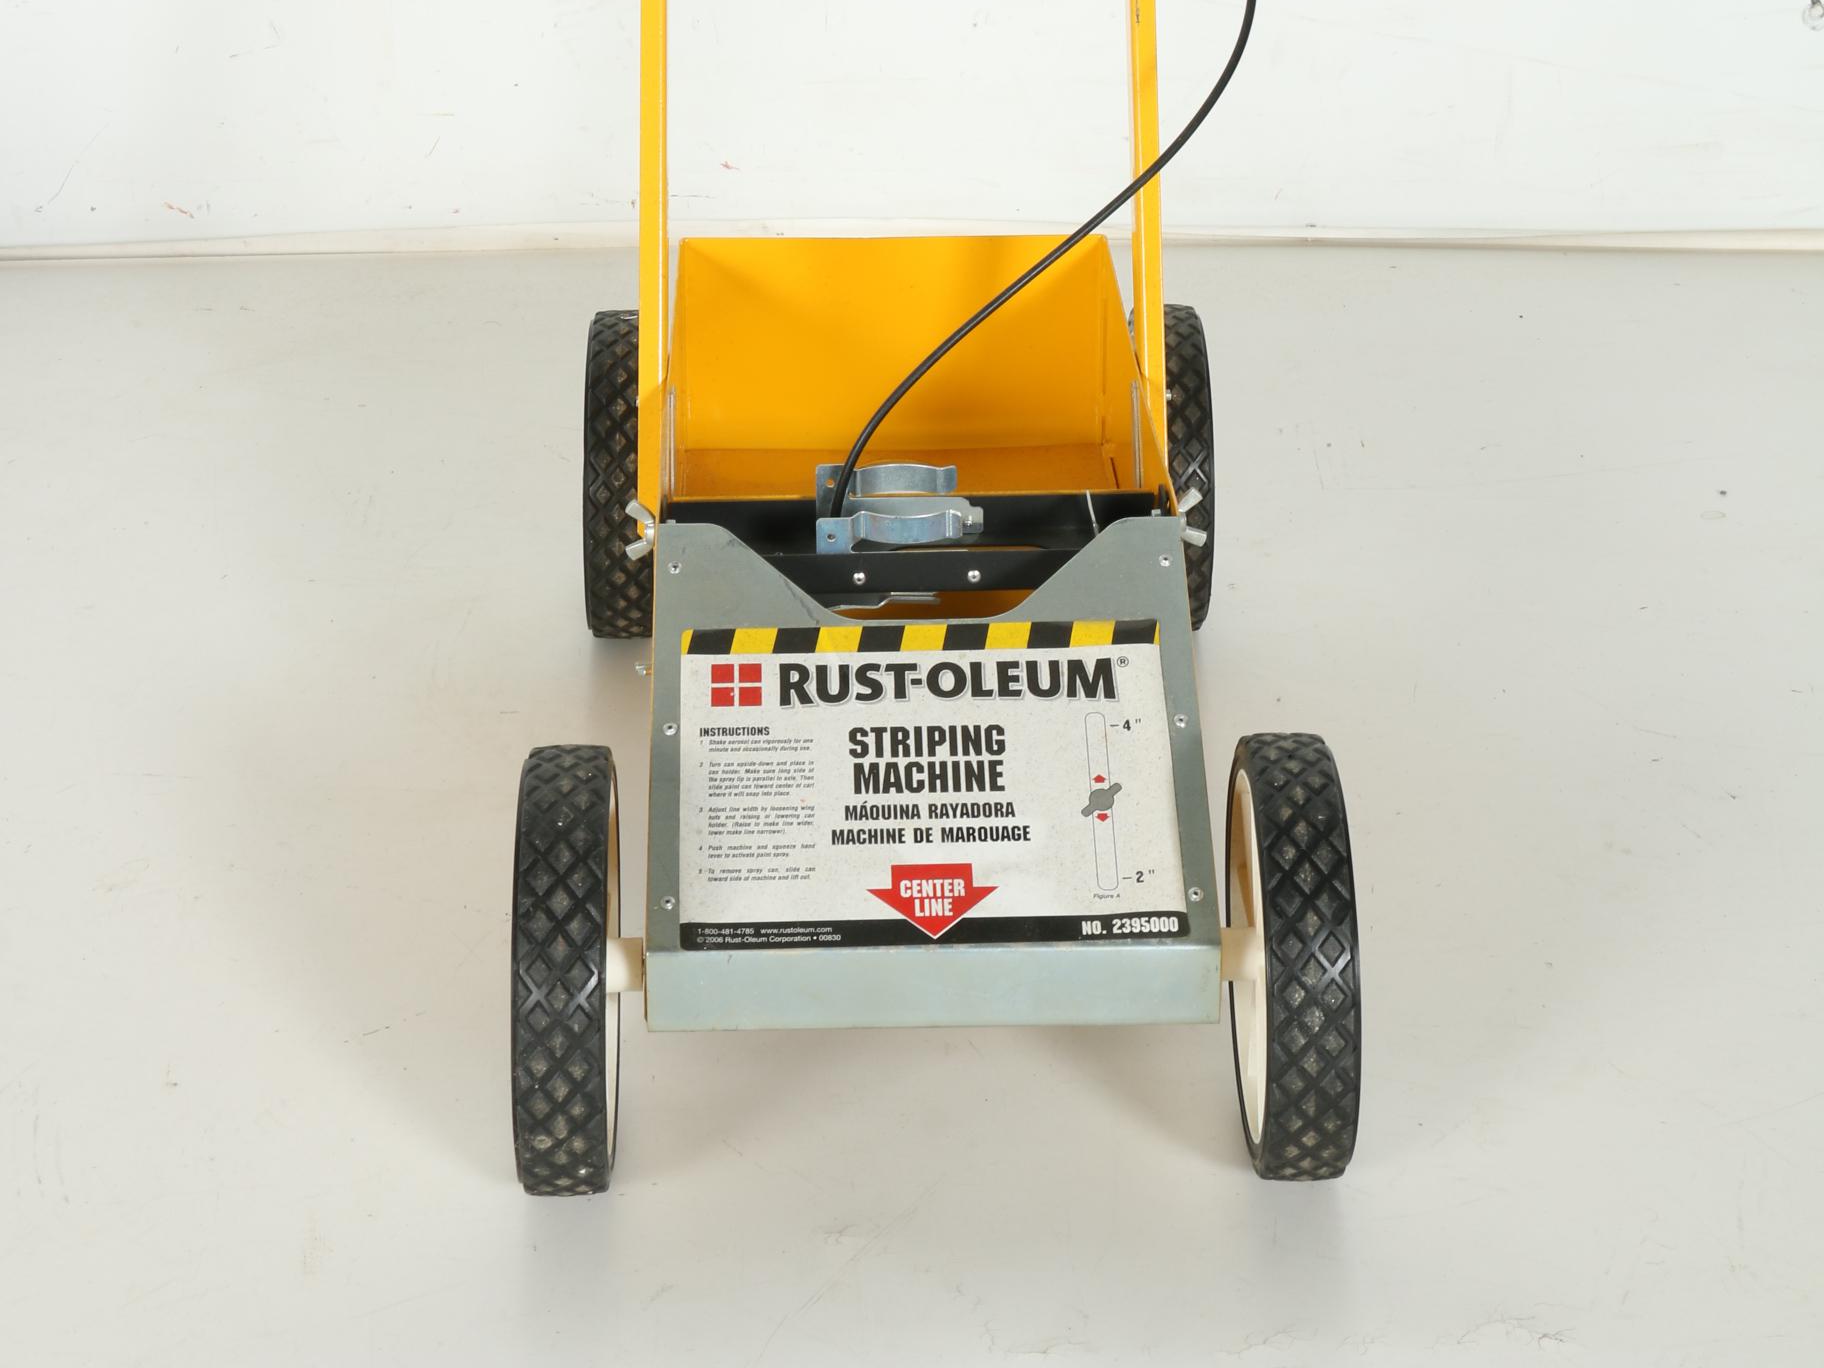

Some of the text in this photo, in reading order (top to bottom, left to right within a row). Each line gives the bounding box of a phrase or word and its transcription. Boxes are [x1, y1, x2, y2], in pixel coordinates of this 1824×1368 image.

[700, 726, 770, 737] INSTRUCTIONS
[848, 724, 1006, 758] STRIPING
[853, 760, 1006, 794] MACHINE
[844, 800, 1016, 821] MÁQUINA RAYADORA
[831, 825, 1031, 846] MACHINE DE MARQUAGE
[900, 879, 966, 898] CENTER
[914, 898, 954, 917] LINE
[1082, 917, 1179, 935] NO. 2395000
